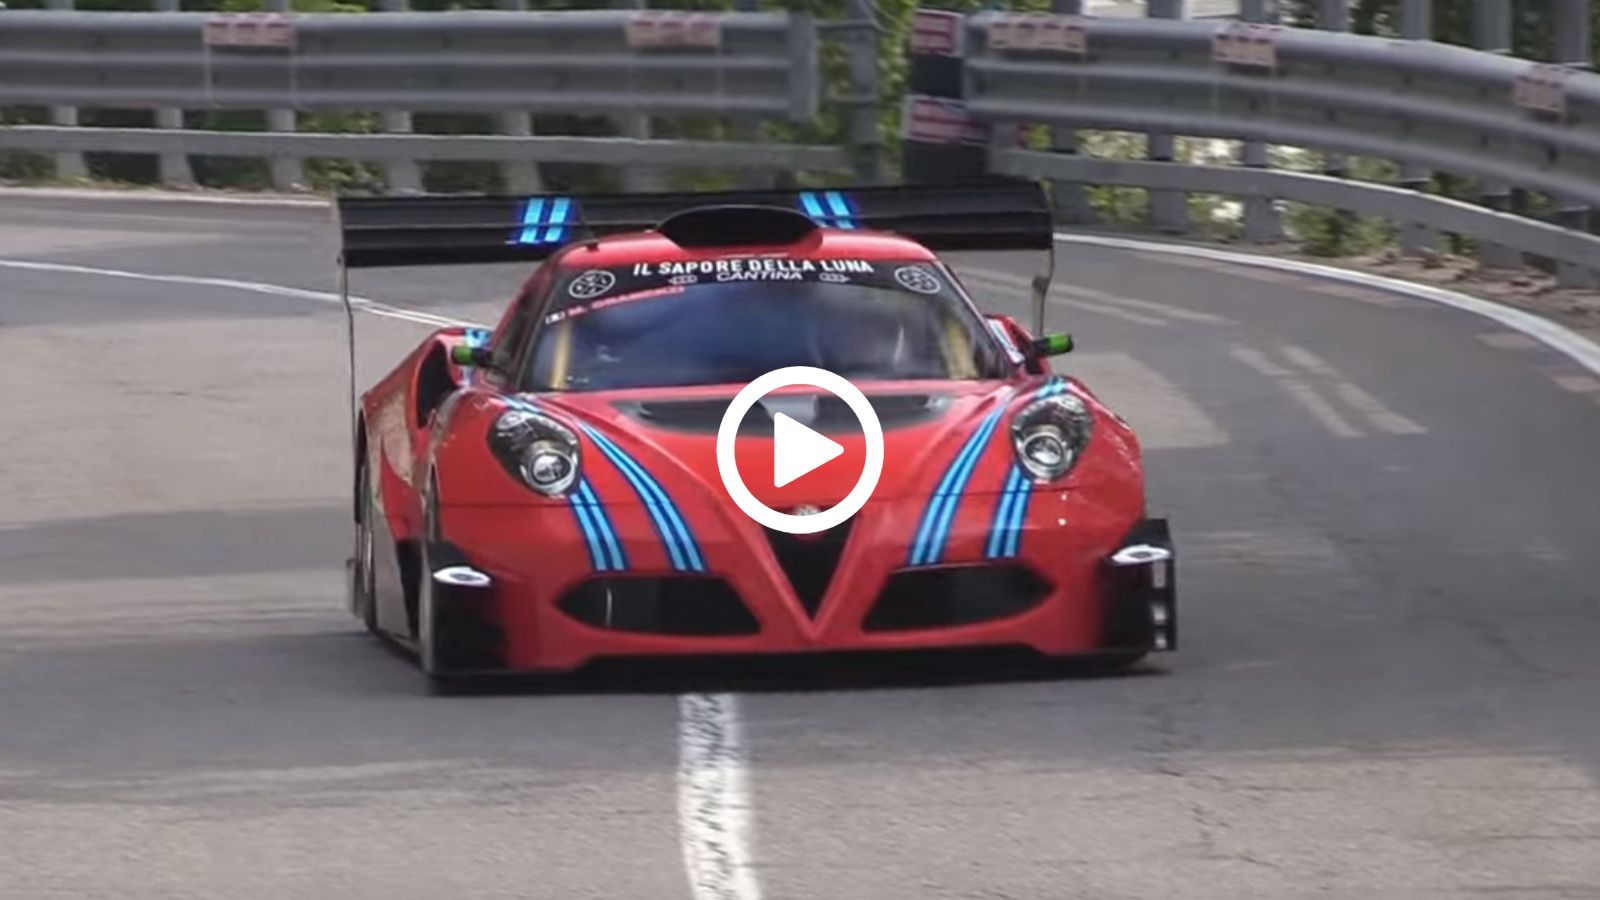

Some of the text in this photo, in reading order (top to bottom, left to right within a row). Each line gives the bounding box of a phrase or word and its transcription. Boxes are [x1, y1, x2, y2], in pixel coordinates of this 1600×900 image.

[633, 258, 875, 276] IL SAPORE DELLA LUNA
[716, 270, 803, 282] CANTINA
